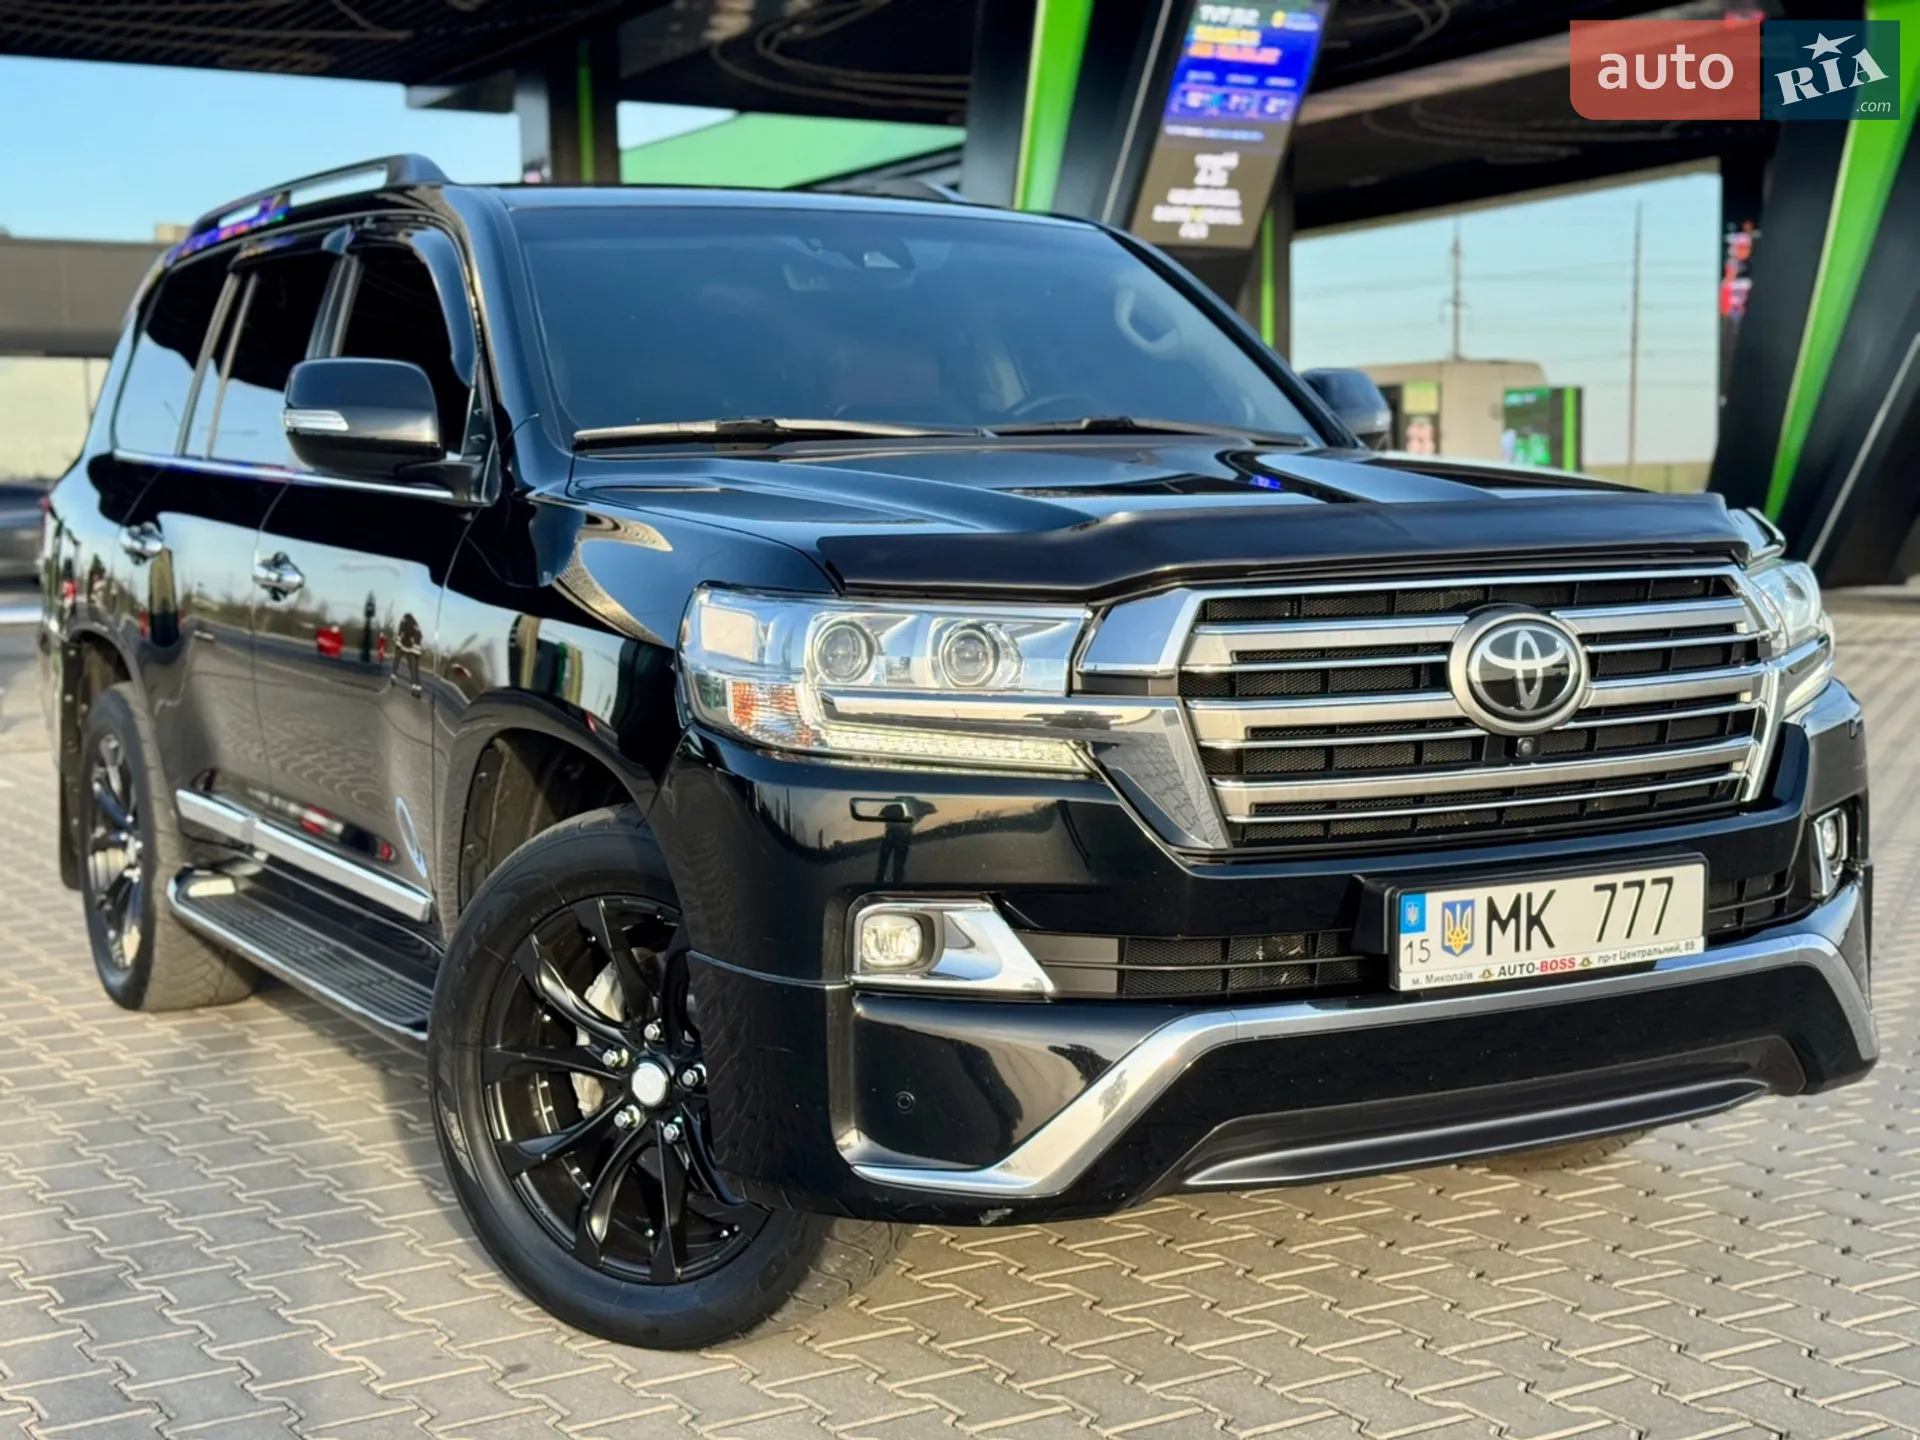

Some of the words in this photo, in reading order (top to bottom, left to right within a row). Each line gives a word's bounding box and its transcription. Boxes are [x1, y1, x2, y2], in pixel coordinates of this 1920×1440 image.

[1486, 889, 1556, 956] MK
[1593, 876, 1674, 943] 777
[1403, 938, 1431, 965] 15
[1425, 971, 1473, 984] Миколаїв
[1497, 957, 1576, 978] AUTO-BOSS
